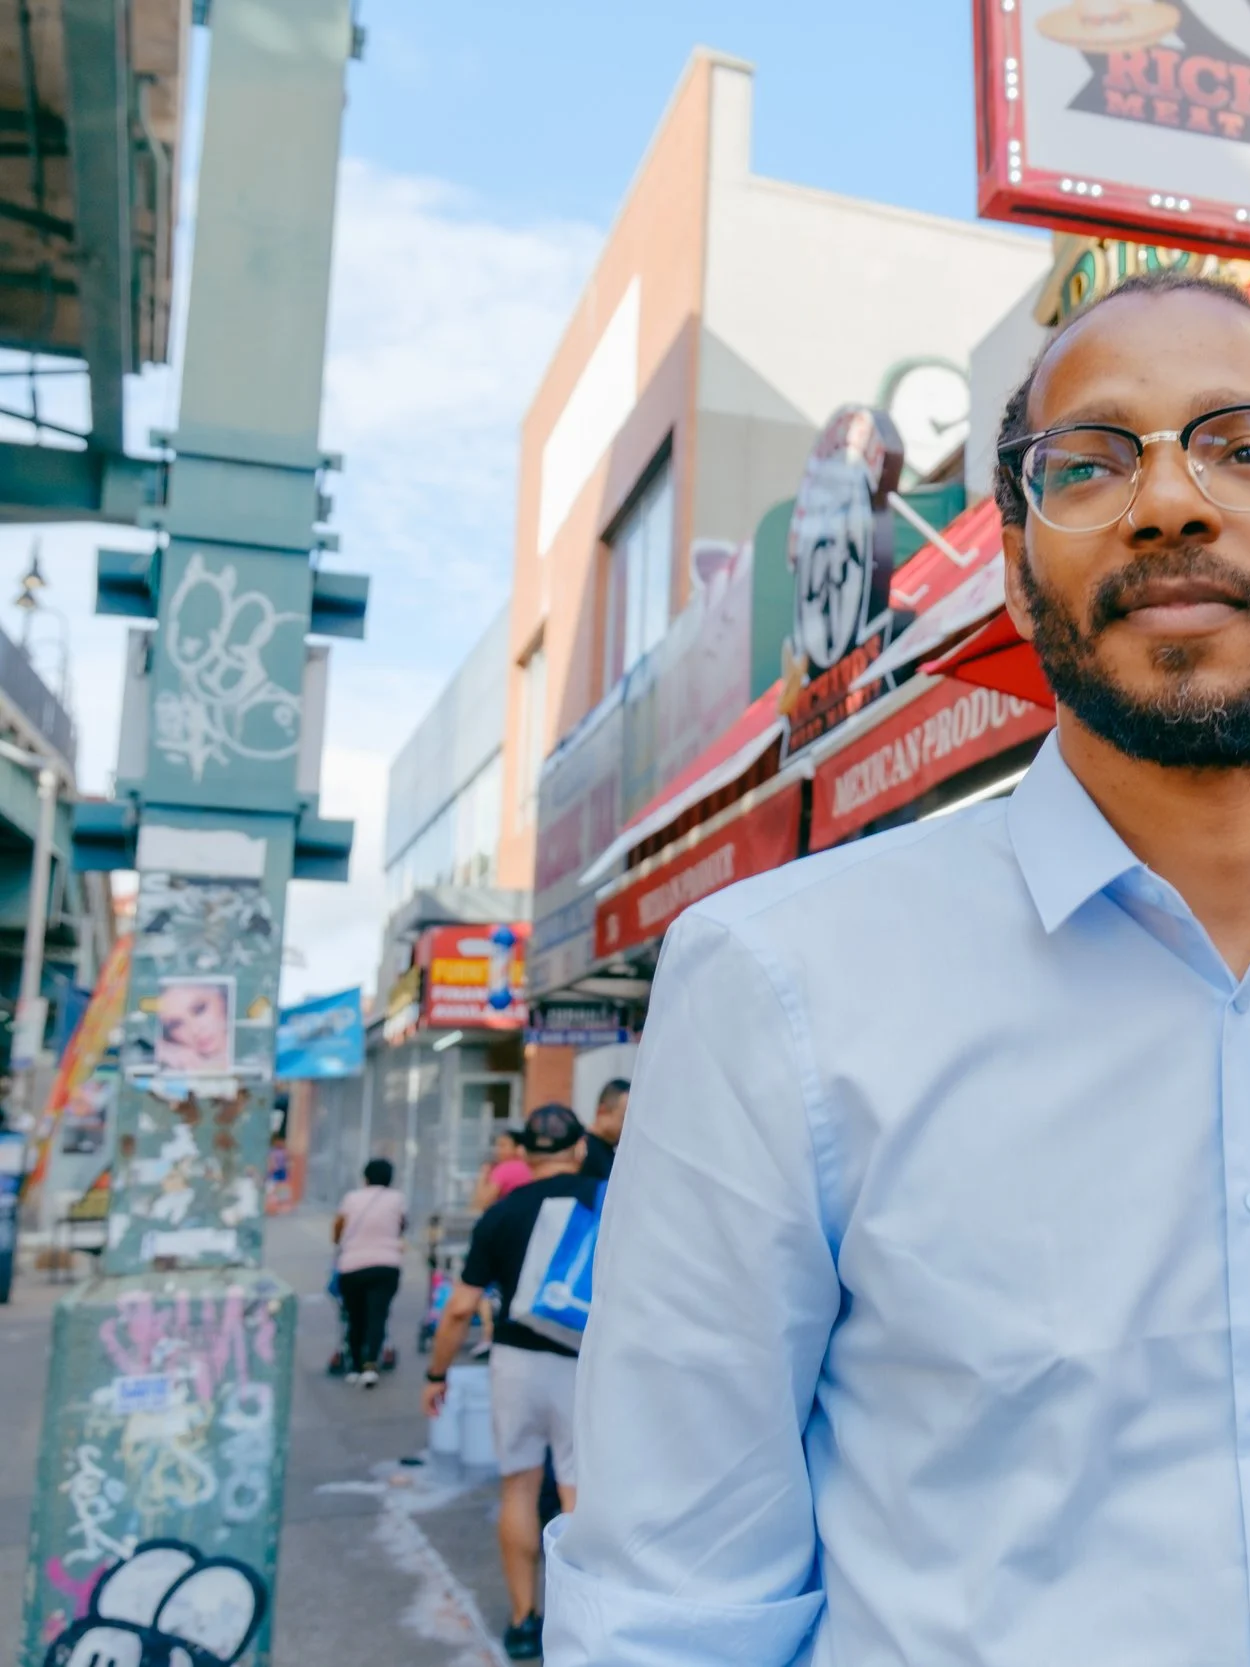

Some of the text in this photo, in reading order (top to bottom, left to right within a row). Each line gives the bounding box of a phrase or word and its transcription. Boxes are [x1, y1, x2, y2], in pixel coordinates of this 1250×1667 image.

[1105, 89, 1245, 139] MEAT
[832, 726, 921, 818] MEXICAN
[921, 687, 1036, 765] PRODU
